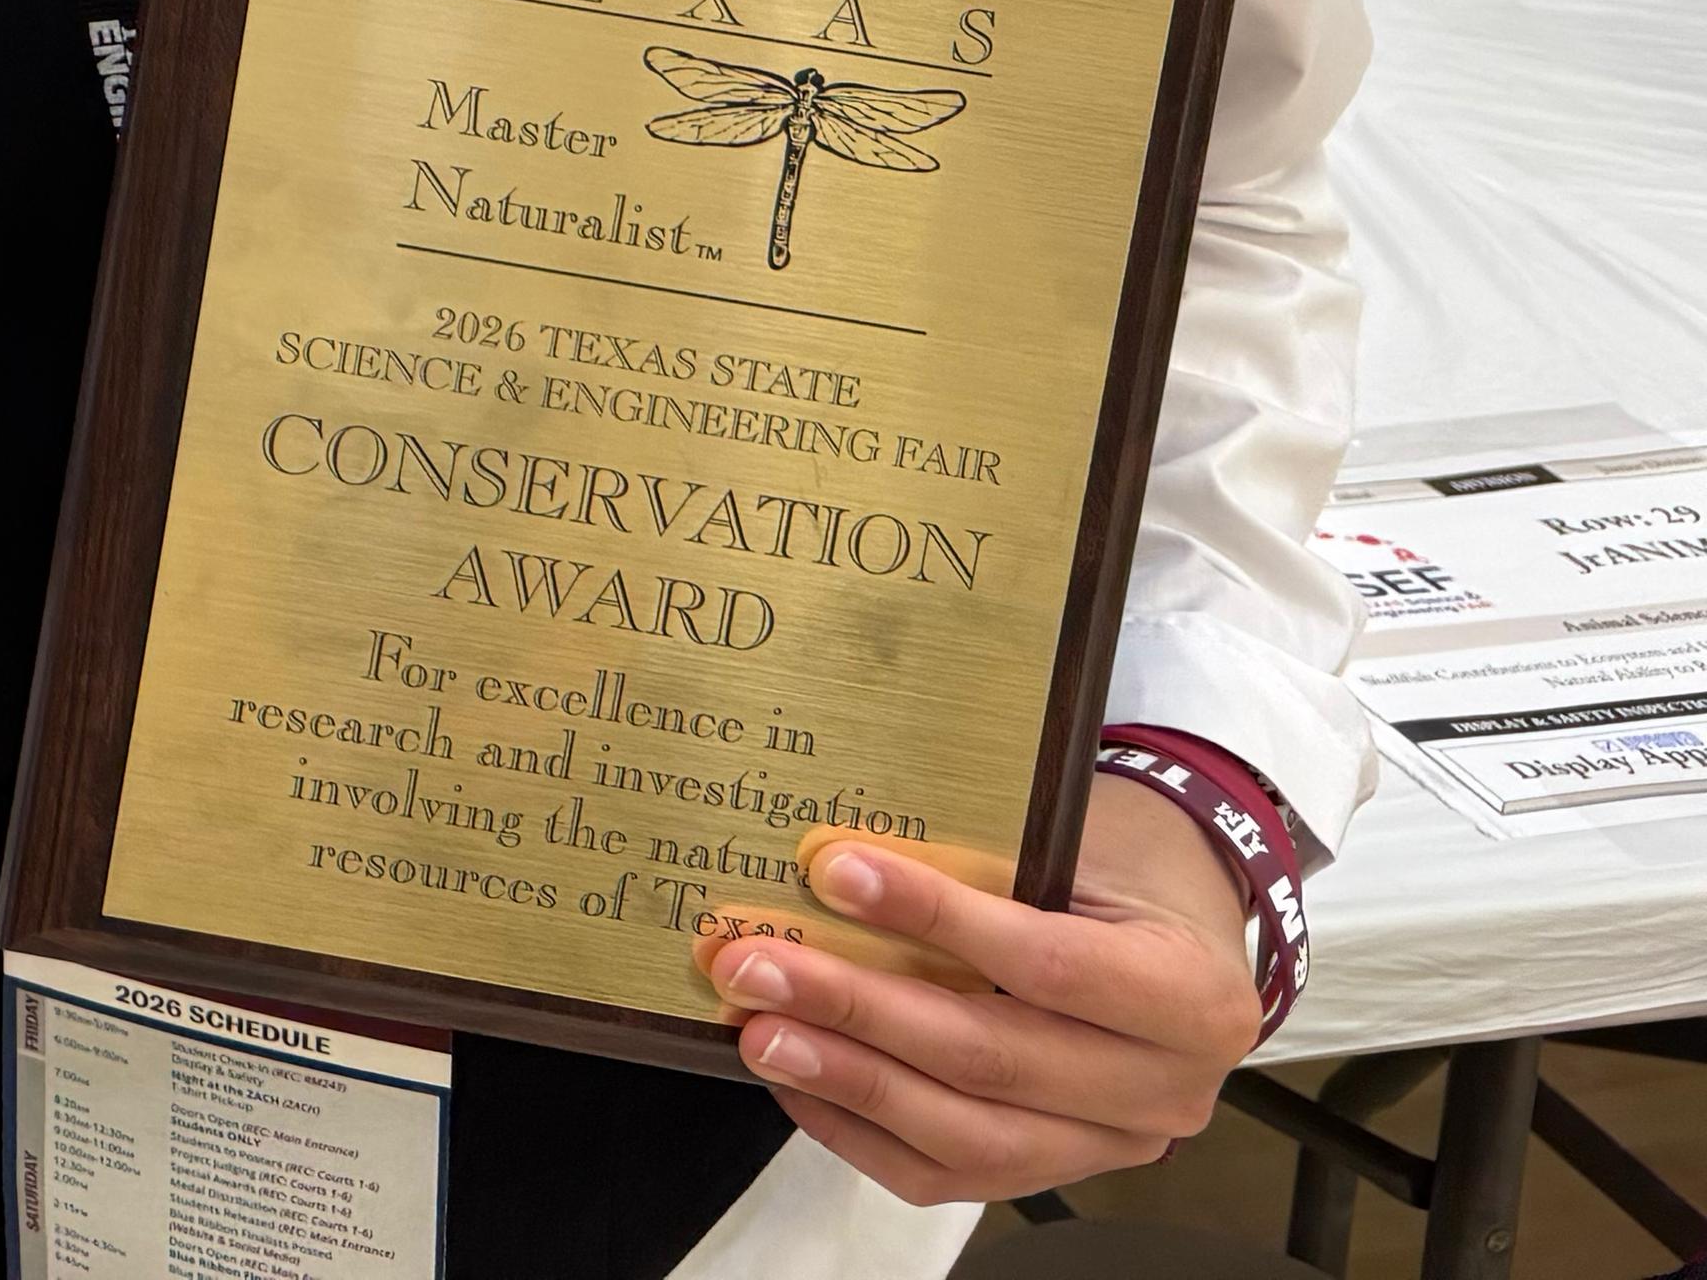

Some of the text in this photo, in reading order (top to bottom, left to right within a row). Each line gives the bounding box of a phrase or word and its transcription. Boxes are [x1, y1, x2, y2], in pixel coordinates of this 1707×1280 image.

[417, 79, 618, 159] Master
[431, 307, 861, 409] 2026 TEXAS STATE
[275, 331, 1001, 487] SCIENCE & ENGINEERING FAIR
[261, 412, 991, 591] CONSERVATION
[1538, 505, 1702, 537] Row: 29
[432, 545, 777, 651] AWARD
[360, 629, 820, 759] For excellence in
[1451, 714, 1534, 733] DISPLAY
[1546, 706, 1613, 726] SAFETY
[228, 692, 929, 844] research and investigation
[288, 756, 524, 849] involving
[544, 795, 629, 858] the
[1505, 751, 1637, 781] Display
[307, 837, 559, 910] resources
[579, 871, 639, 923] of
[24, 994, 39, 1052] FRIDAY
[115, 985, 331, 1056] 2026 SCHEDULE
[171, 1115, 261, 1147] Students ONLY
[24, 1151, 39, 1232] SATURDAY
